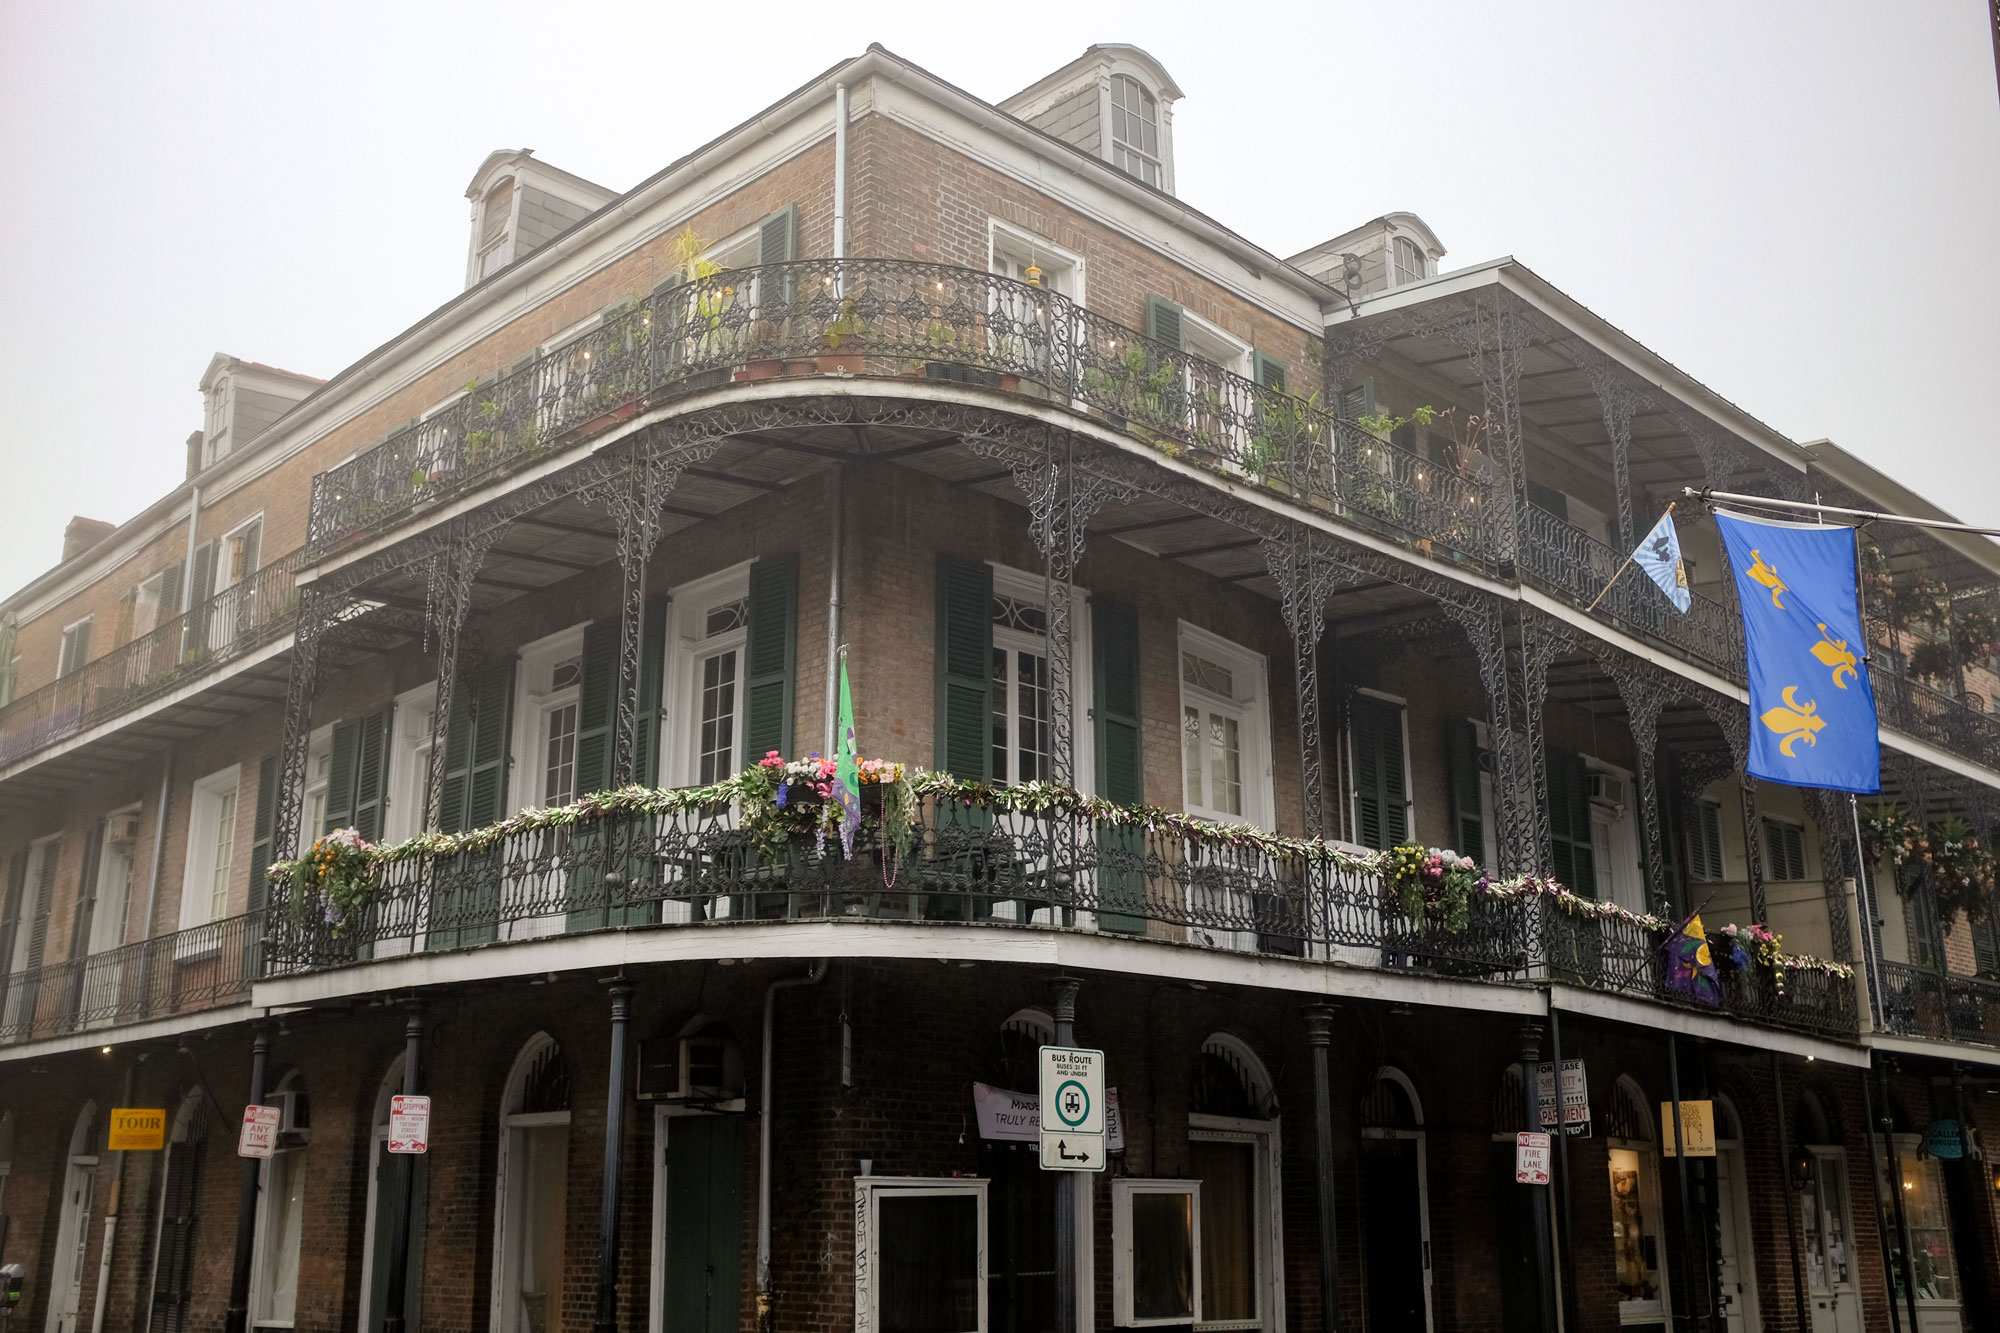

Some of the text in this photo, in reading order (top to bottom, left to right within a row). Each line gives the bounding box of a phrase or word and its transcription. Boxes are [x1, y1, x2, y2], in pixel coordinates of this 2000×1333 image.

[1052, 1054, 1092, 1065] BUS ROUTE
[1536, 1062, 1580, 1074] FOR EASE
[392, 1101, 428, 1112] NO STOPPING
[246, 1109, 256, 1120] NO
[995, 1113, 1026, 1126] TRULY
[115, 1117, 161, 1129] TOUR
[1106, 1106, 1118, 1141] TRULY
[250, 1125, 270, 1134] ANY
[249, 1133, 268, 1143] TIME
[1519, 1135, 1529, 1145] NO
[1525, 1150, 1541, 1158] FIRE
[1523, 1161, 1542, 1169] LANE
